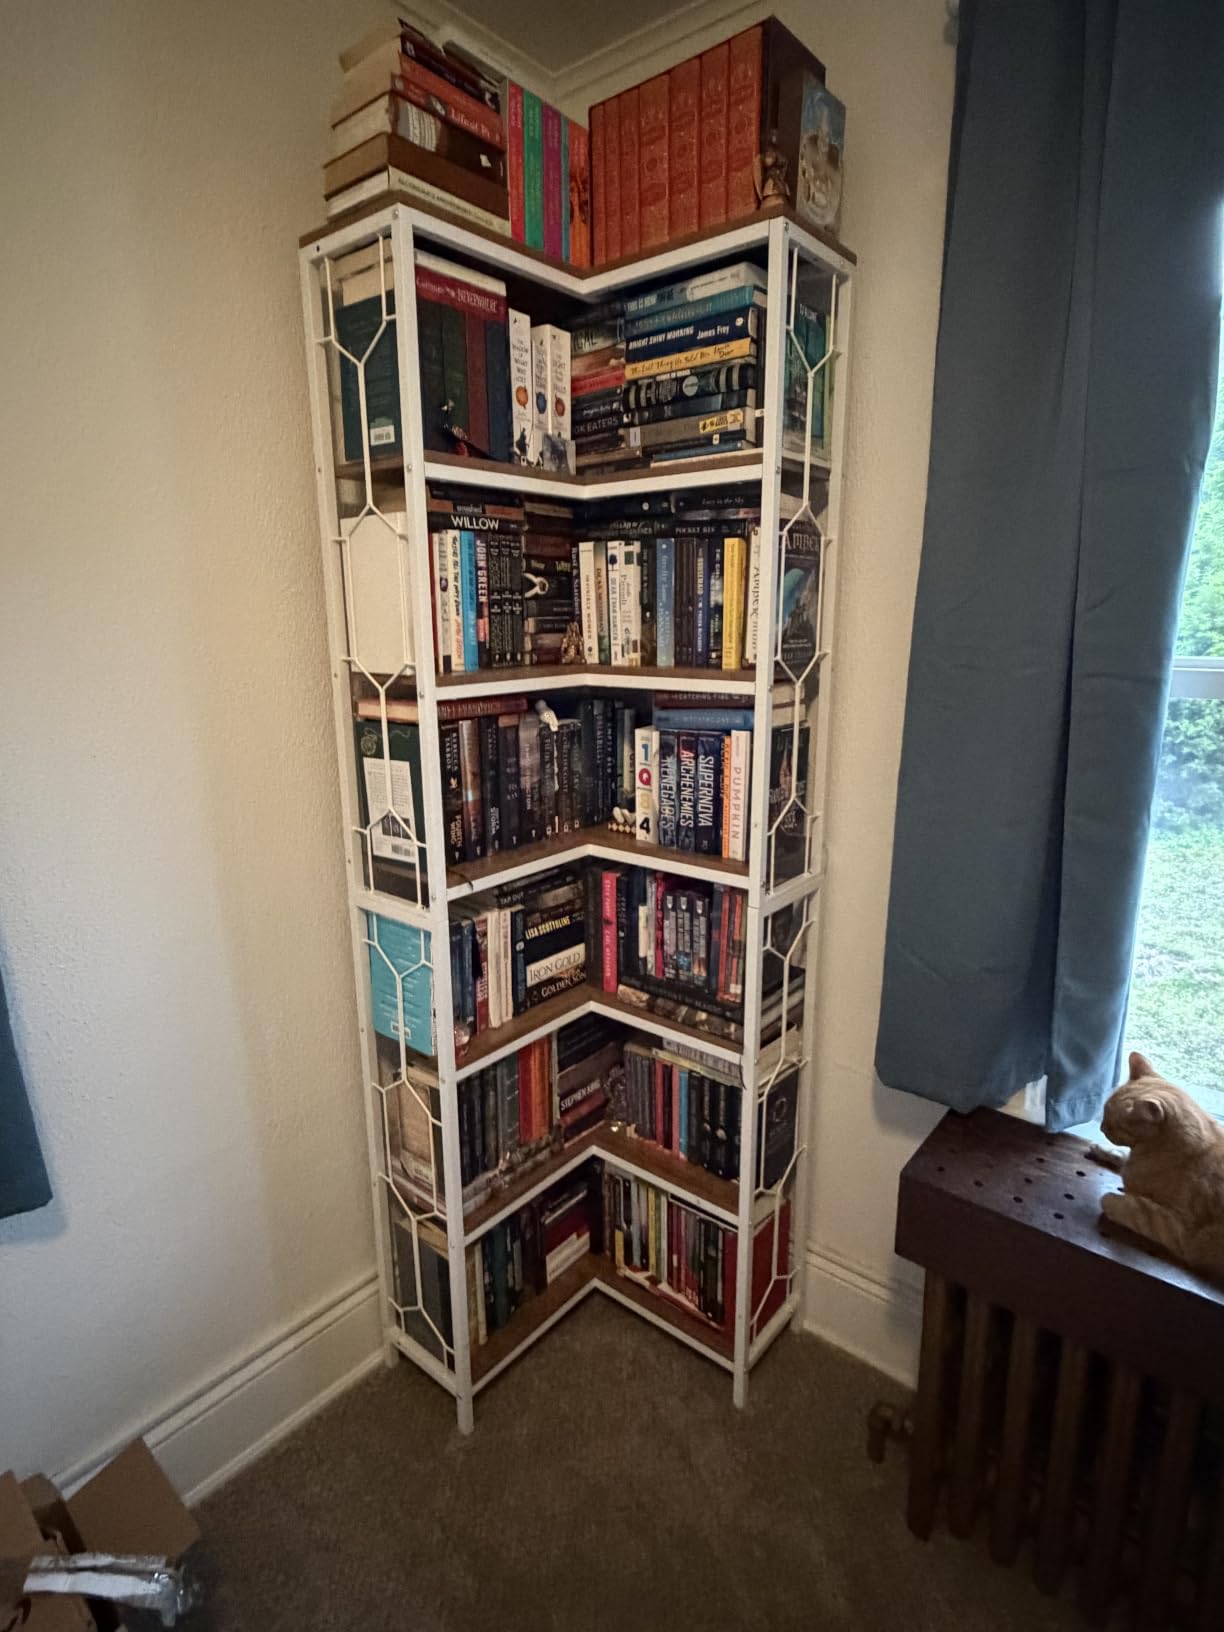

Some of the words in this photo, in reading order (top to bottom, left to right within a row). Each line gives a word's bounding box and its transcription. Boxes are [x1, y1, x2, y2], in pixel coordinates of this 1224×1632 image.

[629, 335, 649, 350] BRIGHT
[649, 331, 666, 346] SHINY
[667, 325, 694, 341] MORNING
[697, 328, 716, 340] James
[717, 324, 730, 336] Frey
[587, 415, 619, 432] EATERS
[451, 514, 499, 531] WILLOW
[476, 539, 487, 568] JOHN
[477, 569, 488, 602] GREEN
[573, 578, 581, 616] Stardust
[680, 749, 695, 828] ARCHENEMIES
[698, 755, 714, 827] SUPERNOVA
[731, 766, 742, 840] PUMPKIN
[526, 926, 539, 940] LISA
[539, 914, 571, 935] SCOTTOLINE
[529, 965, 553, 983] IRON
[554, 951, 581, 971] GOLD
[541, 978, 572, 998] GOLDEN
[560, 1088, 587, 1111] STEPHEN
